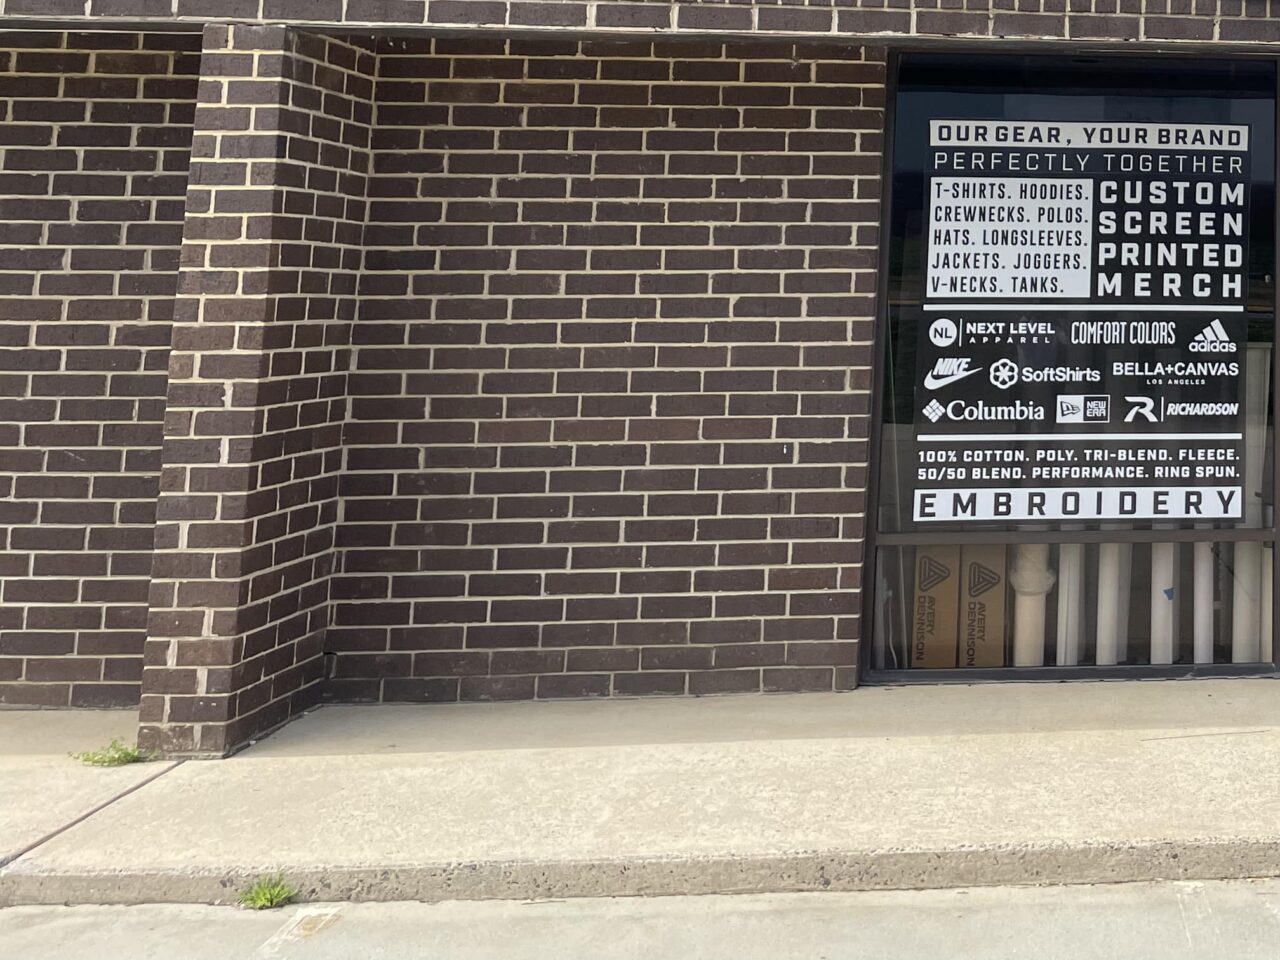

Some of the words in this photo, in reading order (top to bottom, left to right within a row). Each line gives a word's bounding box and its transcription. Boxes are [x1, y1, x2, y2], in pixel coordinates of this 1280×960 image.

[938, 125, 988, 141] OUR
[1083, 127, 1149, 144] YOUR
[1158, 129, 1241, 146] BRAND
[934, 153, 1090, 172] PERFECTLY
[1103, 154, 1242, 174] TOGETHER
[935, 183, 1011, 199] T-SHIRTS.
[1020, 184, 1089, 200] HOODIES.
[1099, 181, 1244, 206] CUSTOM
[934, 206, 1030, 223] CREWNECKS.
[1038, 207, 1089, 223] POLOS.
[1099, 212, 1243, 236] SCREEN
[934, 229, 975, 245] HATS.
[982, 230, 1088, 247] LONGSLEEVES.
[932, 253, 1004, 270] JACKETS.
[1013, 254, 1087, 270] JOGGERS.
[1098, 243, 1243, 267] PRINTED
[931, 277, 1003, 293] V-NECKS.
[1011, 277, 1064, 293] TANKS.
[1097, 273, 1242, 298] MERCH
[934, 328, 952, 338] NL
[966, 323, 1005, 334] NEXT
[1010, 323, 1055, 334] LEVEL
[1071, 321, 1127, 344] COMFORT
[1129, 321, 1176, 344] COLORS
[1189, 340, 1237, 352] adidas
[933, 358, 971, 375] NIKE
[1022, 366, 1101, 382] SoftShirts
[1112, 362, 1239, 376] BELLA+CANVAS
[946, 400, 1044, 420] Columbia
[1086, 409, 1106, 417] ERA
[1167, 403, 1239, 415] RICHARDSON
[918, 451, 956, 462] 100%
[963, 450, 1030, 462] COTTON.
[1036, 450, 1077, 461] POLY.
[1084, 449, 1172, 461] TRI-BLEND.
[1179, 449, 1239, 461] FLEECE.
[918, 468, 966, 480] 50/50
[972, 467, 1026, 479] BLEND.
[1032, 467, 1149, 479] PERFORMANCE.
[1154, 466, 1192, 478] RING
[1196, 466, 1239, 478] SPUN.
[920, 491, 1236, 518] EMBROIDERY
[927, 596, 935, 636] AVERY
[977, 601, 986, 642] AVERY
[916, 596, 926, 660] DENNISON
[967, 602, 976, 666] DENNISON
